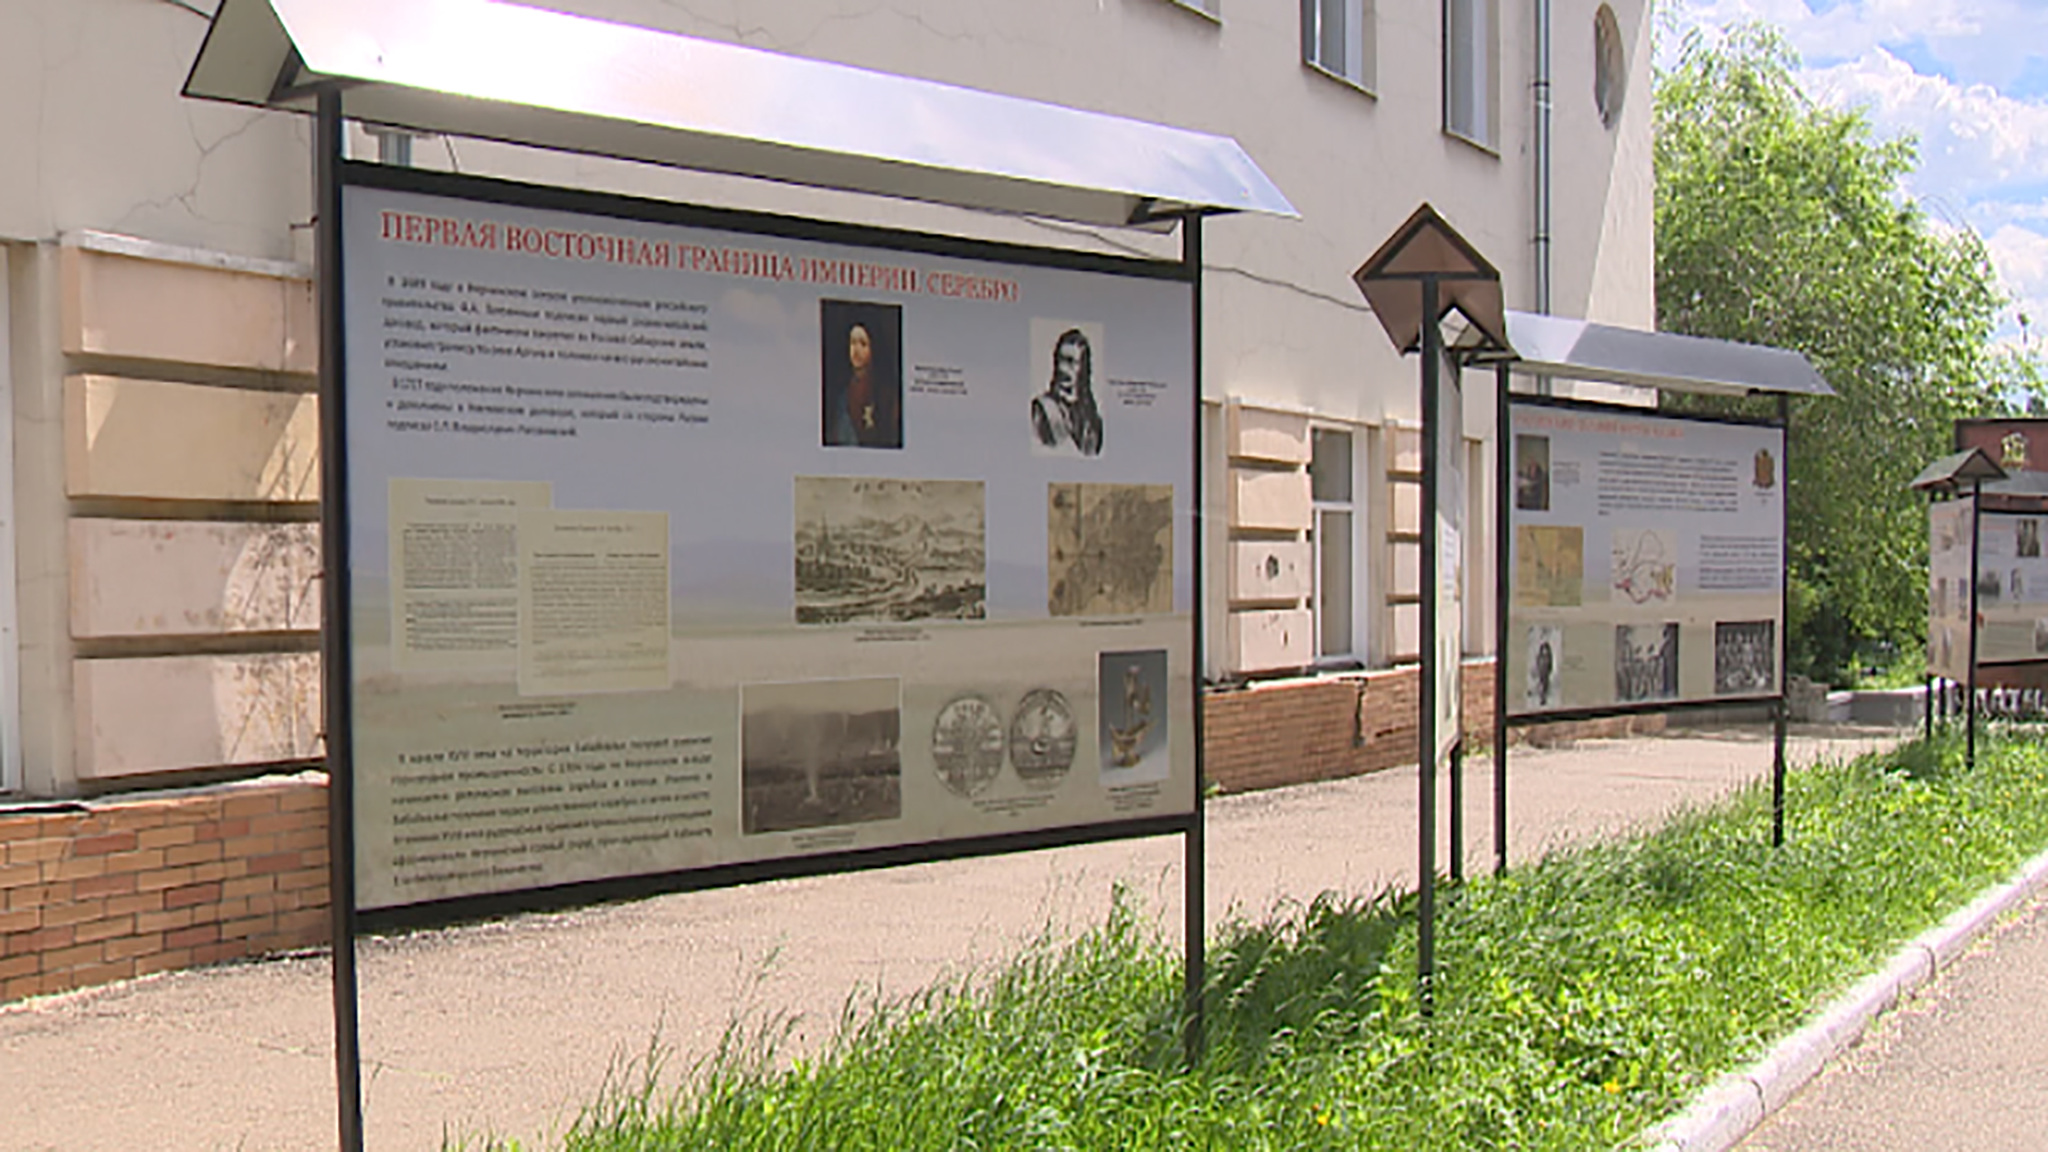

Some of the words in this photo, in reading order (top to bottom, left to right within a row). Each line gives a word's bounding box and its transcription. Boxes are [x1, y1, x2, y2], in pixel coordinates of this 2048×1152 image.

[381, 211, 496, 250] ПЕРВАЯ
[506, 225, 670, 268] ВОСТОЧНАЯ
[677, 244, 795, 282] ГРАНИЦА
